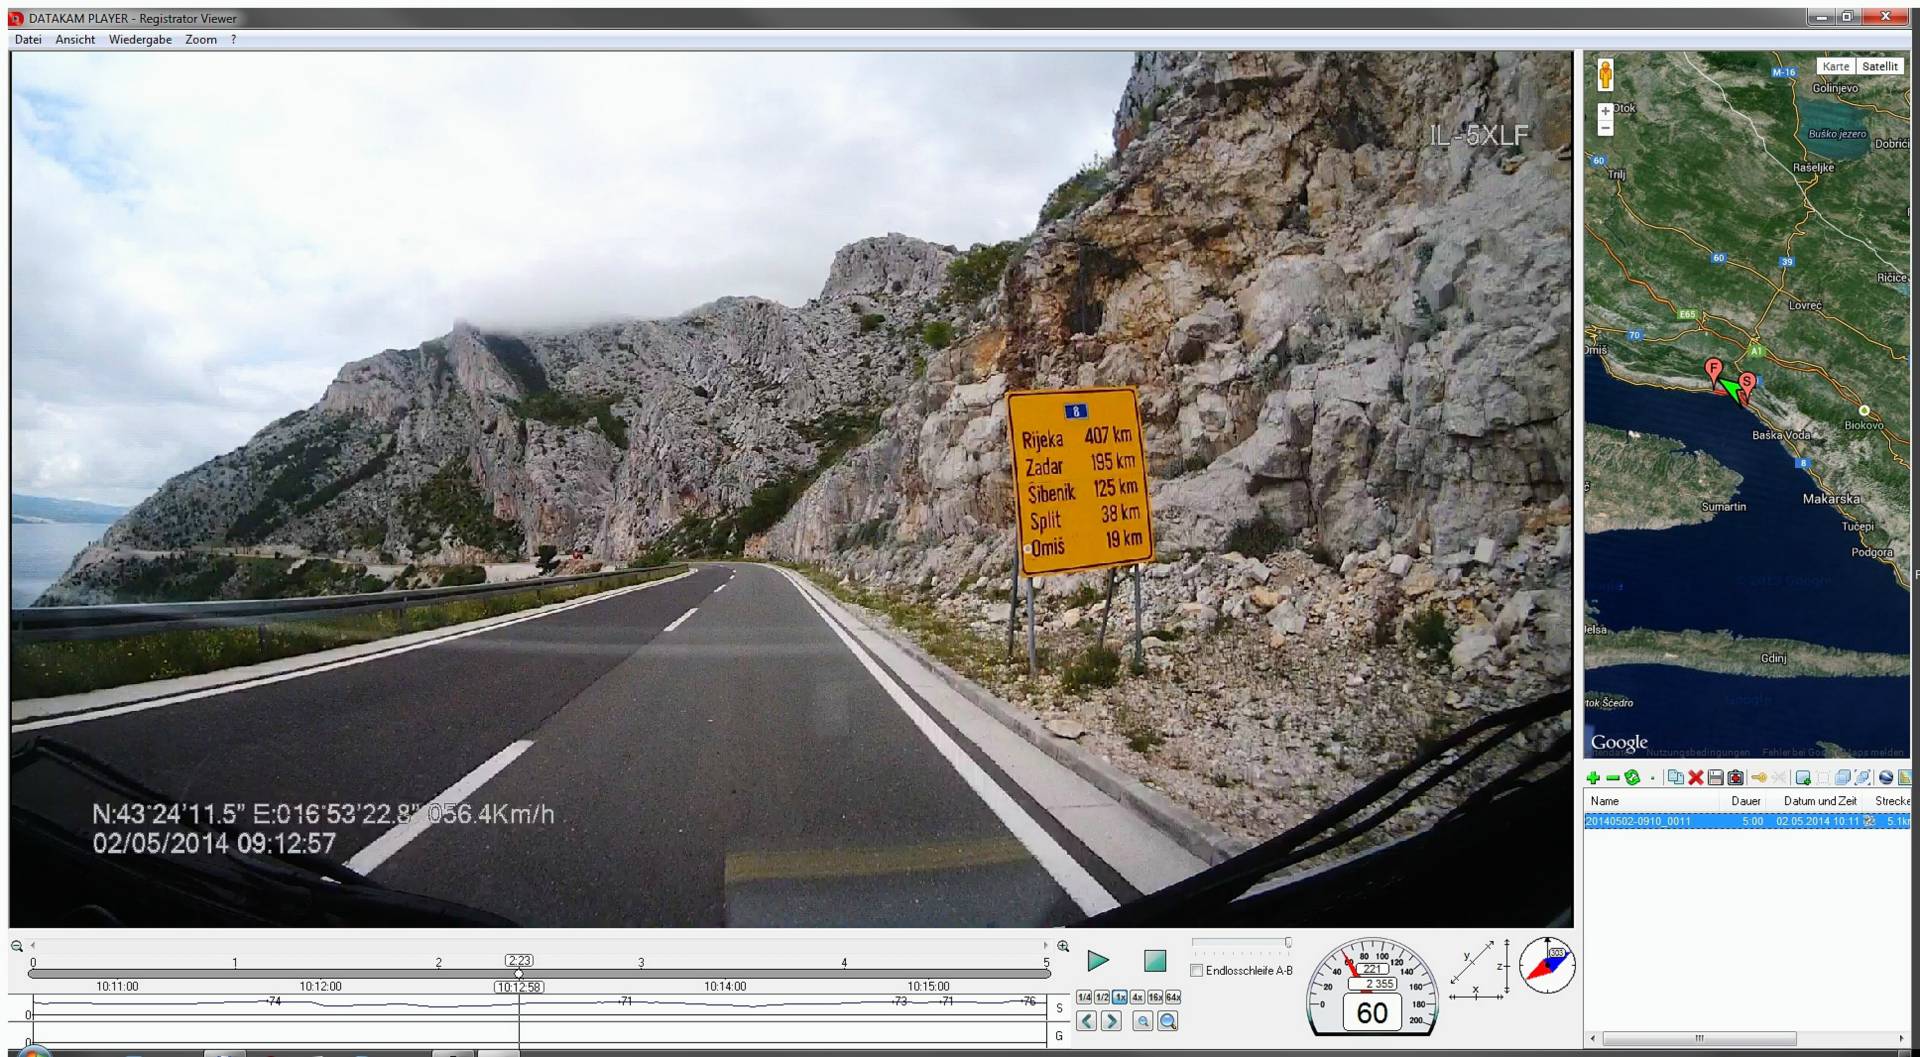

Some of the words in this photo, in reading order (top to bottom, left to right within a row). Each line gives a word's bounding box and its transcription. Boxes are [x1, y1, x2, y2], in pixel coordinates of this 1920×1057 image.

[29, 13, 85, 24] DATAKAM
[88, 13, 128, 24] PLAYER
[139, 13, 198, 27] Registrator
[201, 13, 237, 24] Viewer
[15, 34, 42, 45] Datei
[55, 34, 96, 45] Ansicht
[109, 34, 173, 48] Wiedergabe
[185, 34, 217, 45] Zoom
[231, 34, 237, 45] ?
[1823, 61, 1850, 71] Karte
[1862, 60, 1899, 71] Satellit
[1773, 67, 1796, 77] M-16
[1813, 82, 1859, 95] Golinjevo
[1809, 128, 1838, 139] Buško
[1841, 129, 1868, 141] jezero
[1593, 156, 1605, 165] 60
[1794, 161, 1835, 174] Rašeljke
[1608, 168, 1627, 181] Trilj
[1713, 253, 1724, 263] 60
[1781, 256, 1793, 266] 39
[1877, 271, 1907, 283] Ričice
[1680, 309, 1696, 319] E65
[1628, 330, 1640, 340] 70
[1751, 345, 1762, 355] A1
[1710, 363, 1718, 373] F
[1743, 376, 1751, 386] S
[1073, 406, 1080, 418] 8
[1844, 420, 1884, 431] Biokovo
[1022, 430, 1064, 453] Rijeka
[1084, 426, 1109, 445] 407
[1112, 426, 1132, 443] km
[1752, 429, 1783, 441] Baška
[1785, 429, 1811, 441] Voda
[1026, 458, 1063, 477] Zadar
[1091, 452, 1113, 471] 195
[1116, 452, 1136, 469] km
[1800, 458, 1807, 467] 8
[1094, 478, 1116, 498] 125
[1119, 480, 1138, 495] km
[1803, 492, 1861, 505] Makarska
[1702, 501, 1747, 512] Sumartin
[1031, 510, 1062, 534] Split
[1101, 505, 1118, 523] 38
[1121, 504, 1141, 521] km
[1842, 521, 1875, 533] Tučepi
[1031, 536, 1065, 558] Omiš
[1107, 530, 1120, 548] 19
[1124, 530, 1143, 547] km
[1851, 547, 1893, 560] Podgora
[1761, 653, 1787, 666] Gdinj
[1584, 699, 1600, 708] tok
[1591, 734, 1649, 753] Google
[1591, 796, 1619, 806] Name
[1732, 796, 1761, 806] Dauer
[1784, 795, 1815, 806] Datum
[1818, 795, 1837, 806] und
[1838, 795, 1857, 806] Zeit
[1585, 816, 1691, 827] 20140502-0910_0011
[1743, 816, 1764, 826] 5:00
[1776, 816, 1830, 826] 02.05.2014
[1834, 816, 1859, 826] 10:11
[1464, 952, 1471, 961] y
[1551, 949, 1564, 957] 303
[30, 957, 37, 968] 0
[232, 957, 238, 968] 1
[435, 957, 442, 968] 2
[509, 955, 531, 967] 2:23
[638, 957, 645, 968] 3
[841, 957, 848, 968] 4
[1043, 957, 1050, 968] 5
[1206, 965, 1274, 976] Endlosschleife
[1276, 965, 1293, 976] A-B
[1333, 968, 1342, 976] 40
[1364, 964, 1381, 974] 221
[1401, 968, 1414, 976] 140
[97, 981, 139, 992] 10:11:00
[300, 981, 342, 992] 10:12:00
[498, 982, 541, 993] 10:12:58
[705, 981, 747, 992] 10:14:00
[908, 981, 950, 992] 10:15:00
[1324, 983, 1333, 991] 20
[1376, 979, 1394, 989] 355
[1410, 983, 1423, 991] 160
[1473, 986, 1479, 994] x
[1079, 993, 1091, 1001] 1/4
[1097, 993, 1109, 1001] 1/2
[1116, 993, 1126, 1001] 1x
[1132, 993, 1143, 1001] 4x
[1149, 993, 1163, 1001] 16x
[1166, 993, 1181, 1001] 64x
[1056, 1004, 1063, 1013] S
[1357, 1002, 1388, 1024] 60
[25, 1010, 32, 1020] 0
[1409, 1016, 1423, 1024] 200
[1055, 1031, 1063, 1041] G
